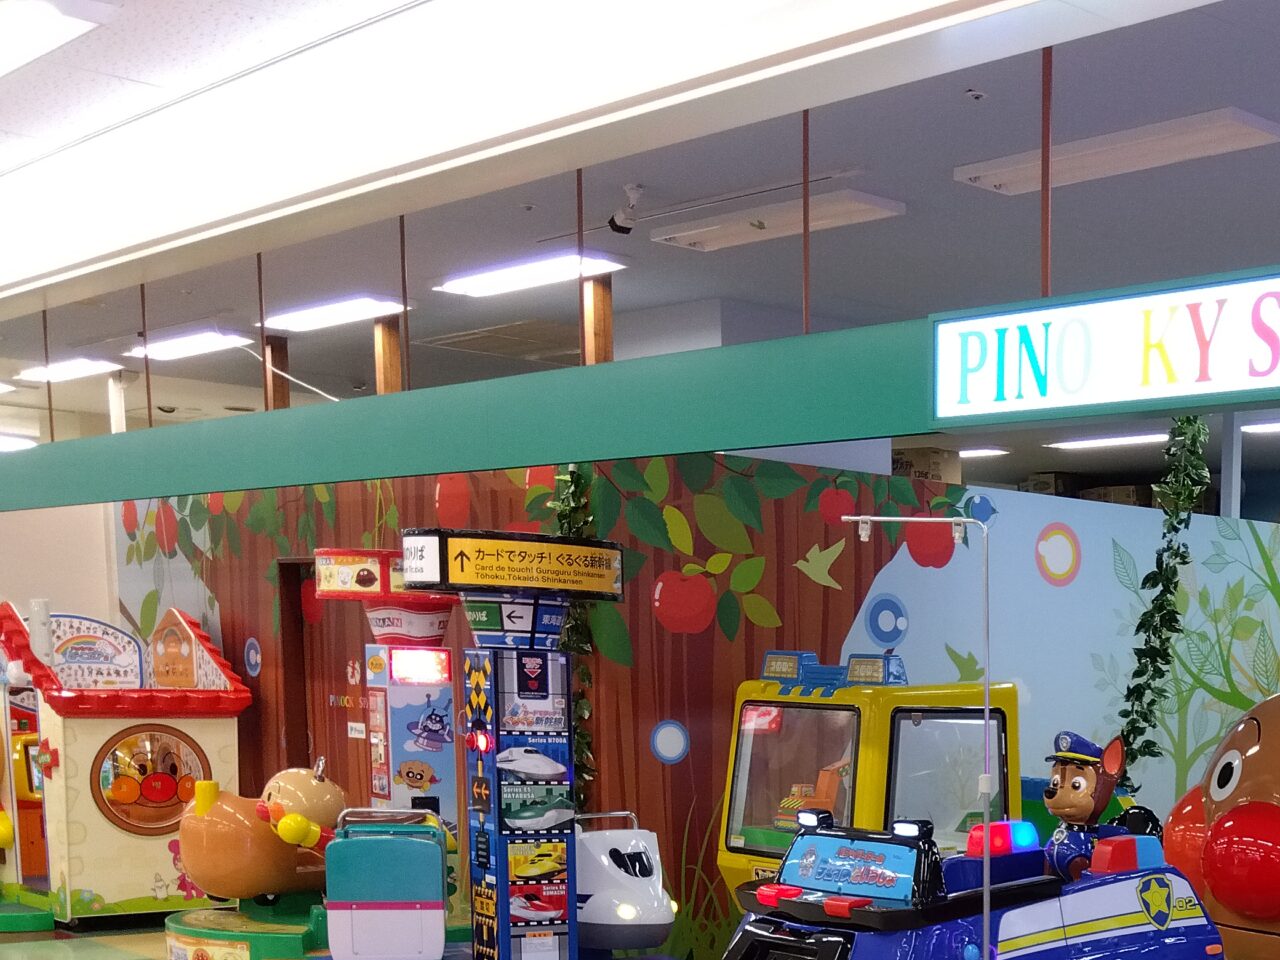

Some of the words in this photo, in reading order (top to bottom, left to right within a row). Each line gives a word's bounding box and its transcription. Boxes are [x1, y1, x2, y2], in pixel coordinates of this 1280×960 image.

[475, 564, 493, 572] Card
[508, 566, 534, 574] touch!
[536, 567, 571, 577] Guruguru
[542, 575, 583, 585] Shinkansen
